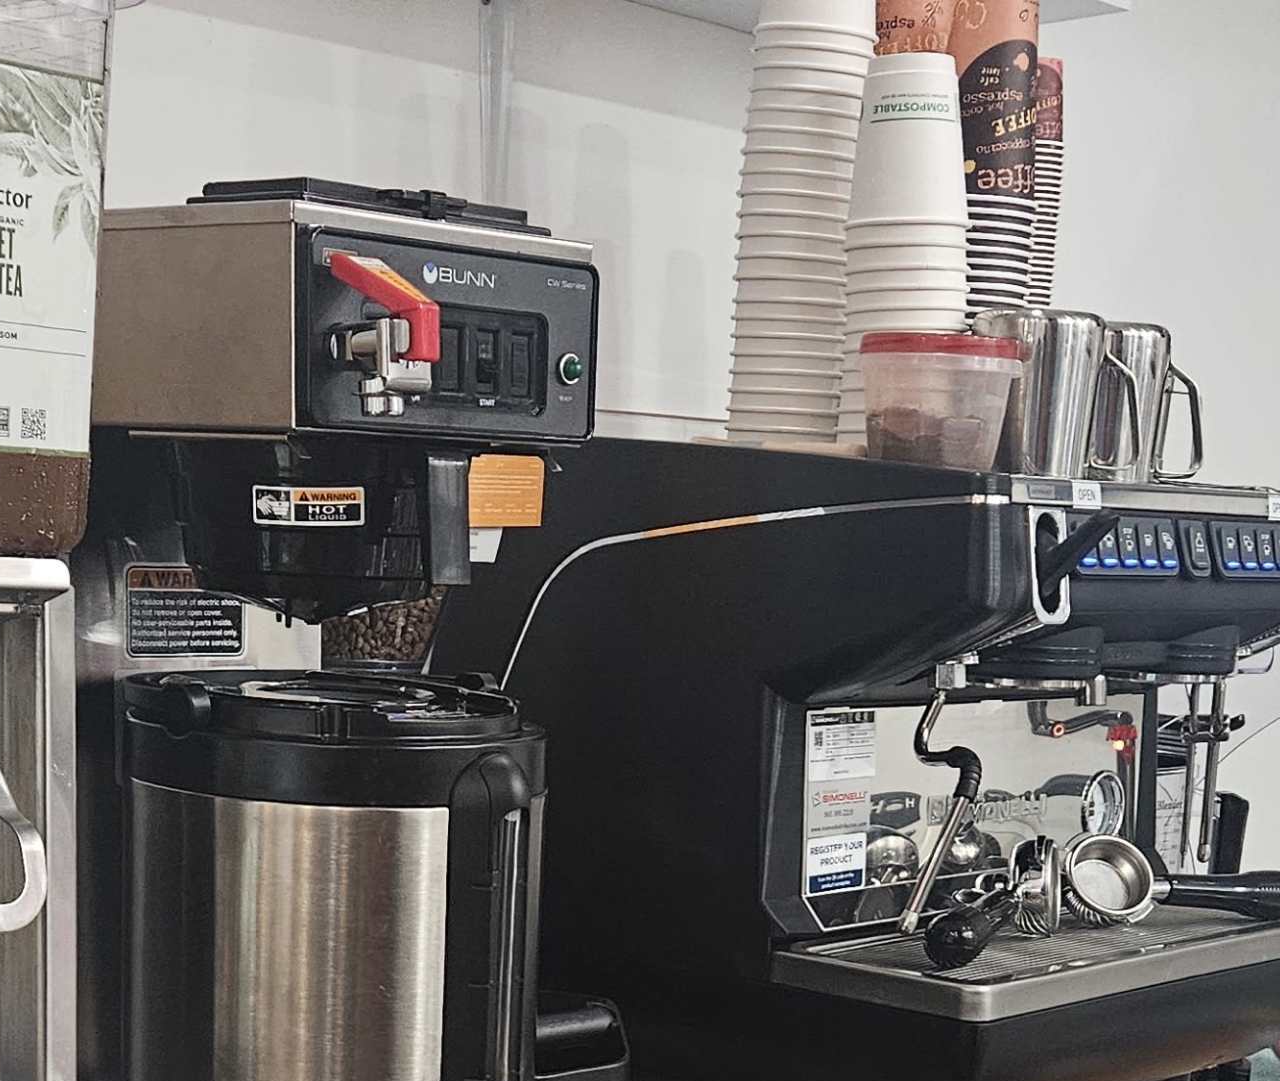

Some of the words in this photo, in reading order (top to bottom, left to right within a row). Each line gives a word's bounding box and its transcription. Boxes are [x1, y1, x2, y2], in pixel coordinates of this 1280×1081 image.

[963, 88, 1024, 103] espresso
[873, 101, 950, 114] COMPOSTABLE
[992, 106, 1037, 137] OFFEE
[977, 164, 1035, 194] ffee
[439, 267, 495, 288] BUNN
[311, 493, 357, 501] WARNING
[308, 505, 347, 514] HOT
